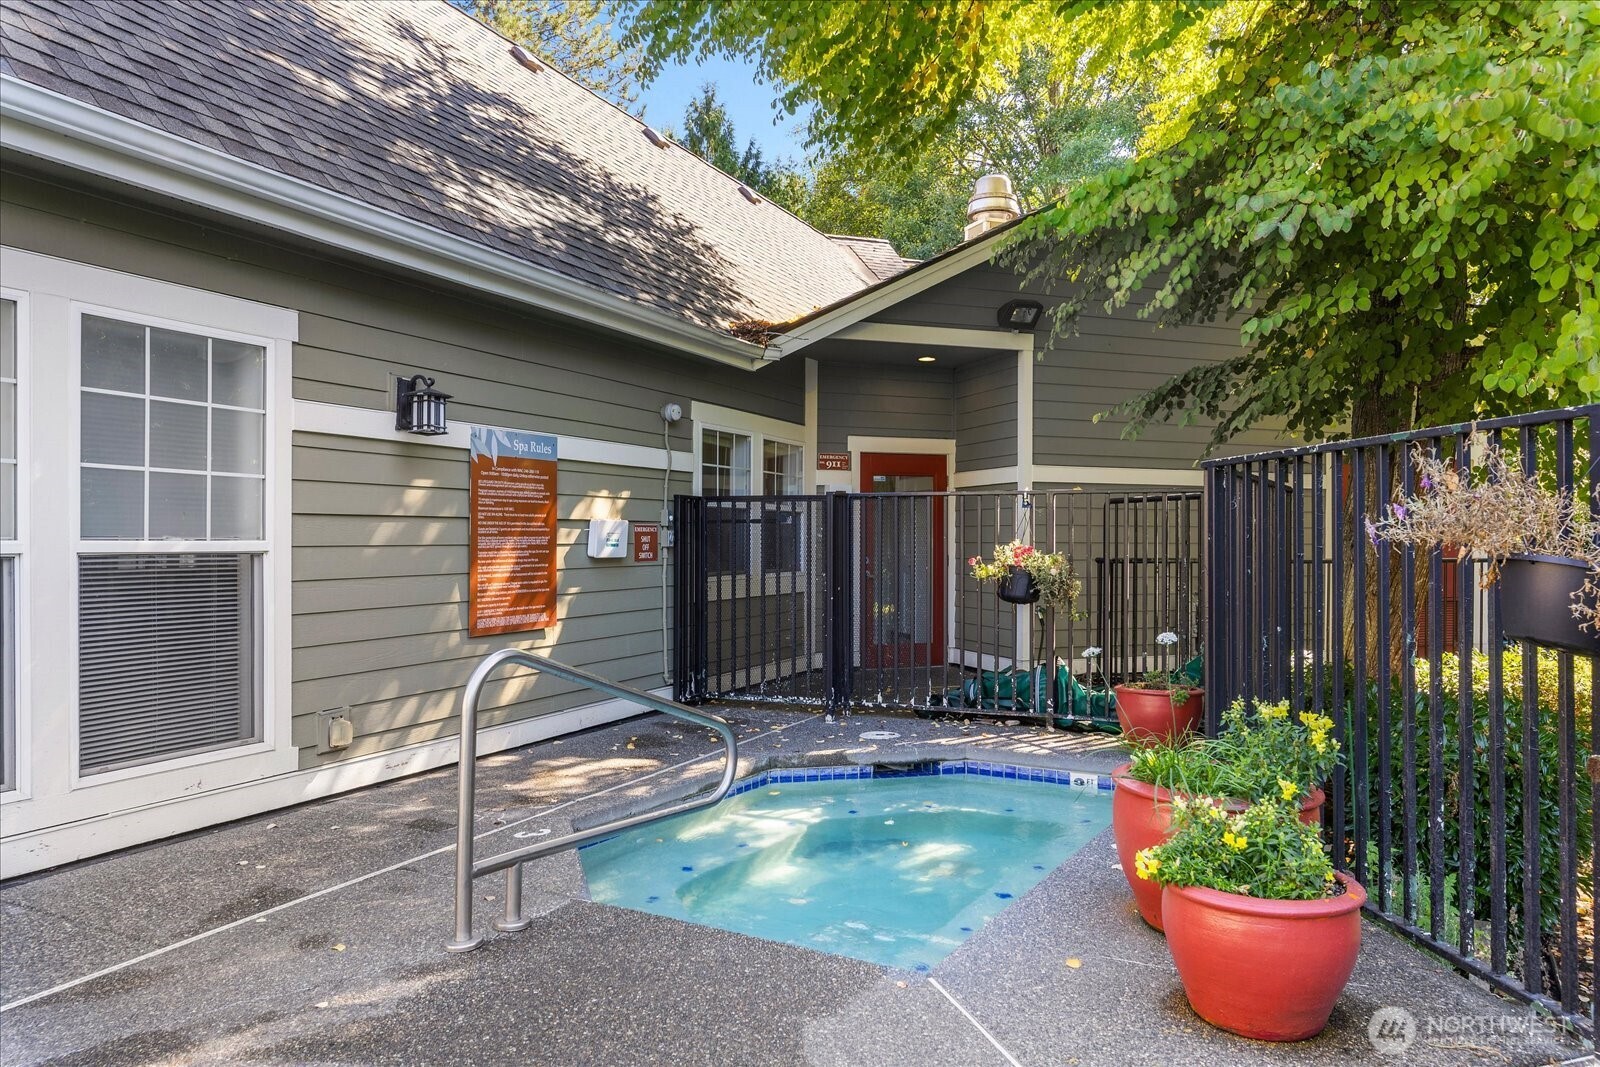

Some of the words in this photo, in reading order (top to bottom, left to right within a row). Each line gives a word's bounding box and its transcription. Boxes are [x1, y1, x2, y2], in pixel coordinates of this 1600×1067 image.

[513, 439, 528, 454] Spa
[530, 441, 552, 454] Rules
[826, 461, 841, 469] 911
[640, 535, 651, 543] SHUT
